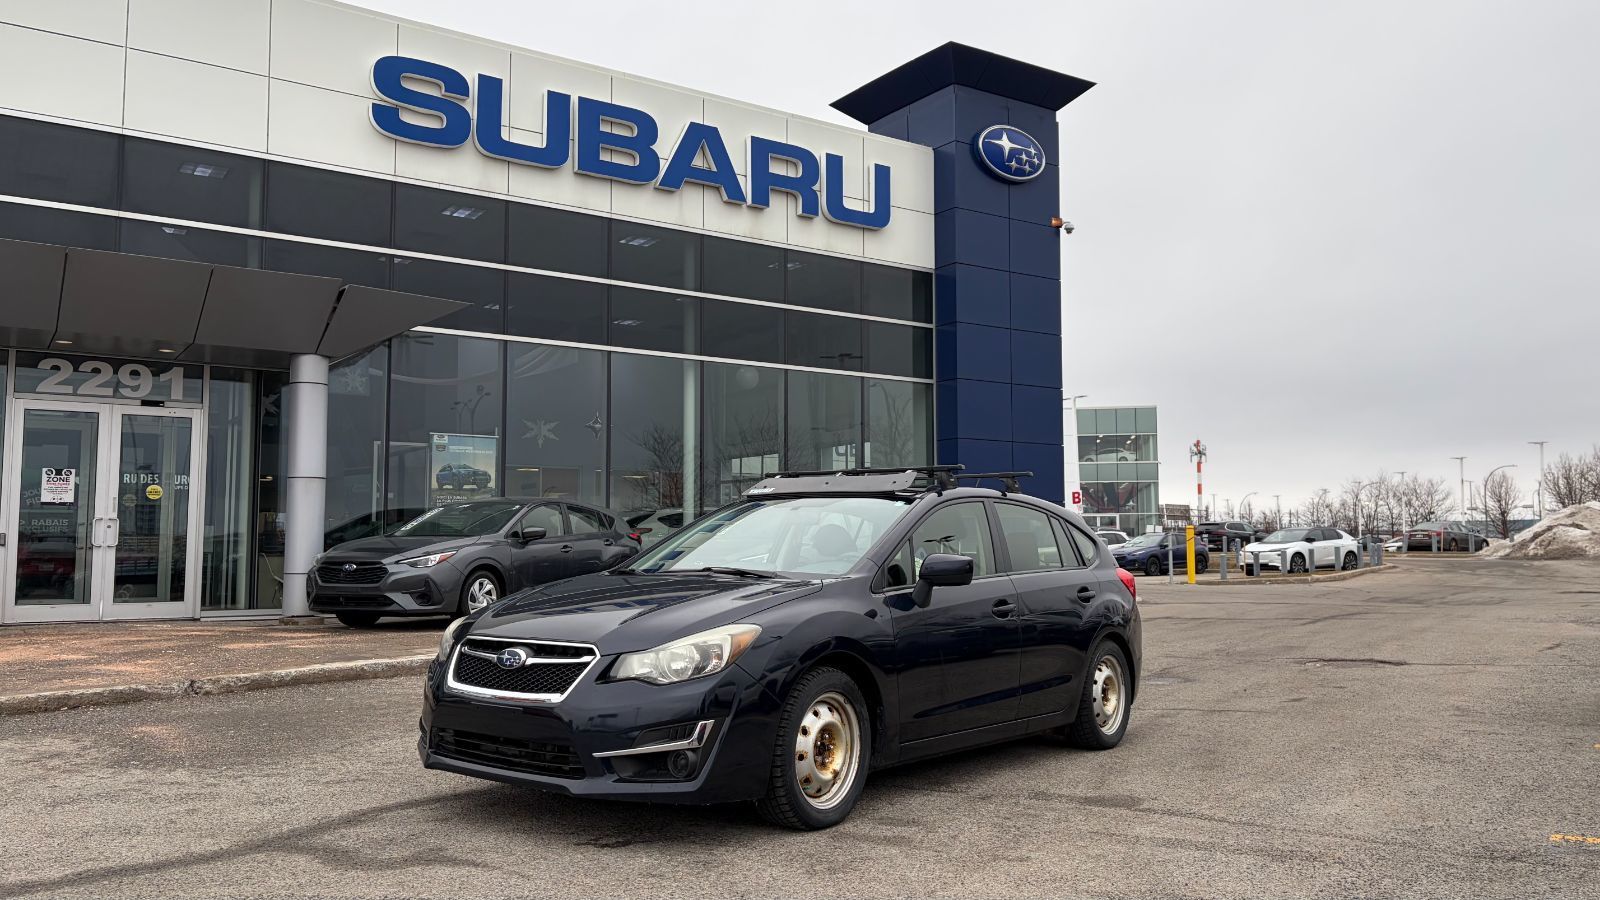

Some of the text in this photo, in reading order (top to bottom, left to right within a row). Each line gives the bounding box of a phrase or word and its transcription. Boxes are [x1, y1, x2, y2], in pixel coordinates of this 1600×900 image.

[370, 55, 891, 229] SUBARU
[36, 358, 184, 400] 2291
[1072, 491, 1081, 504] B
